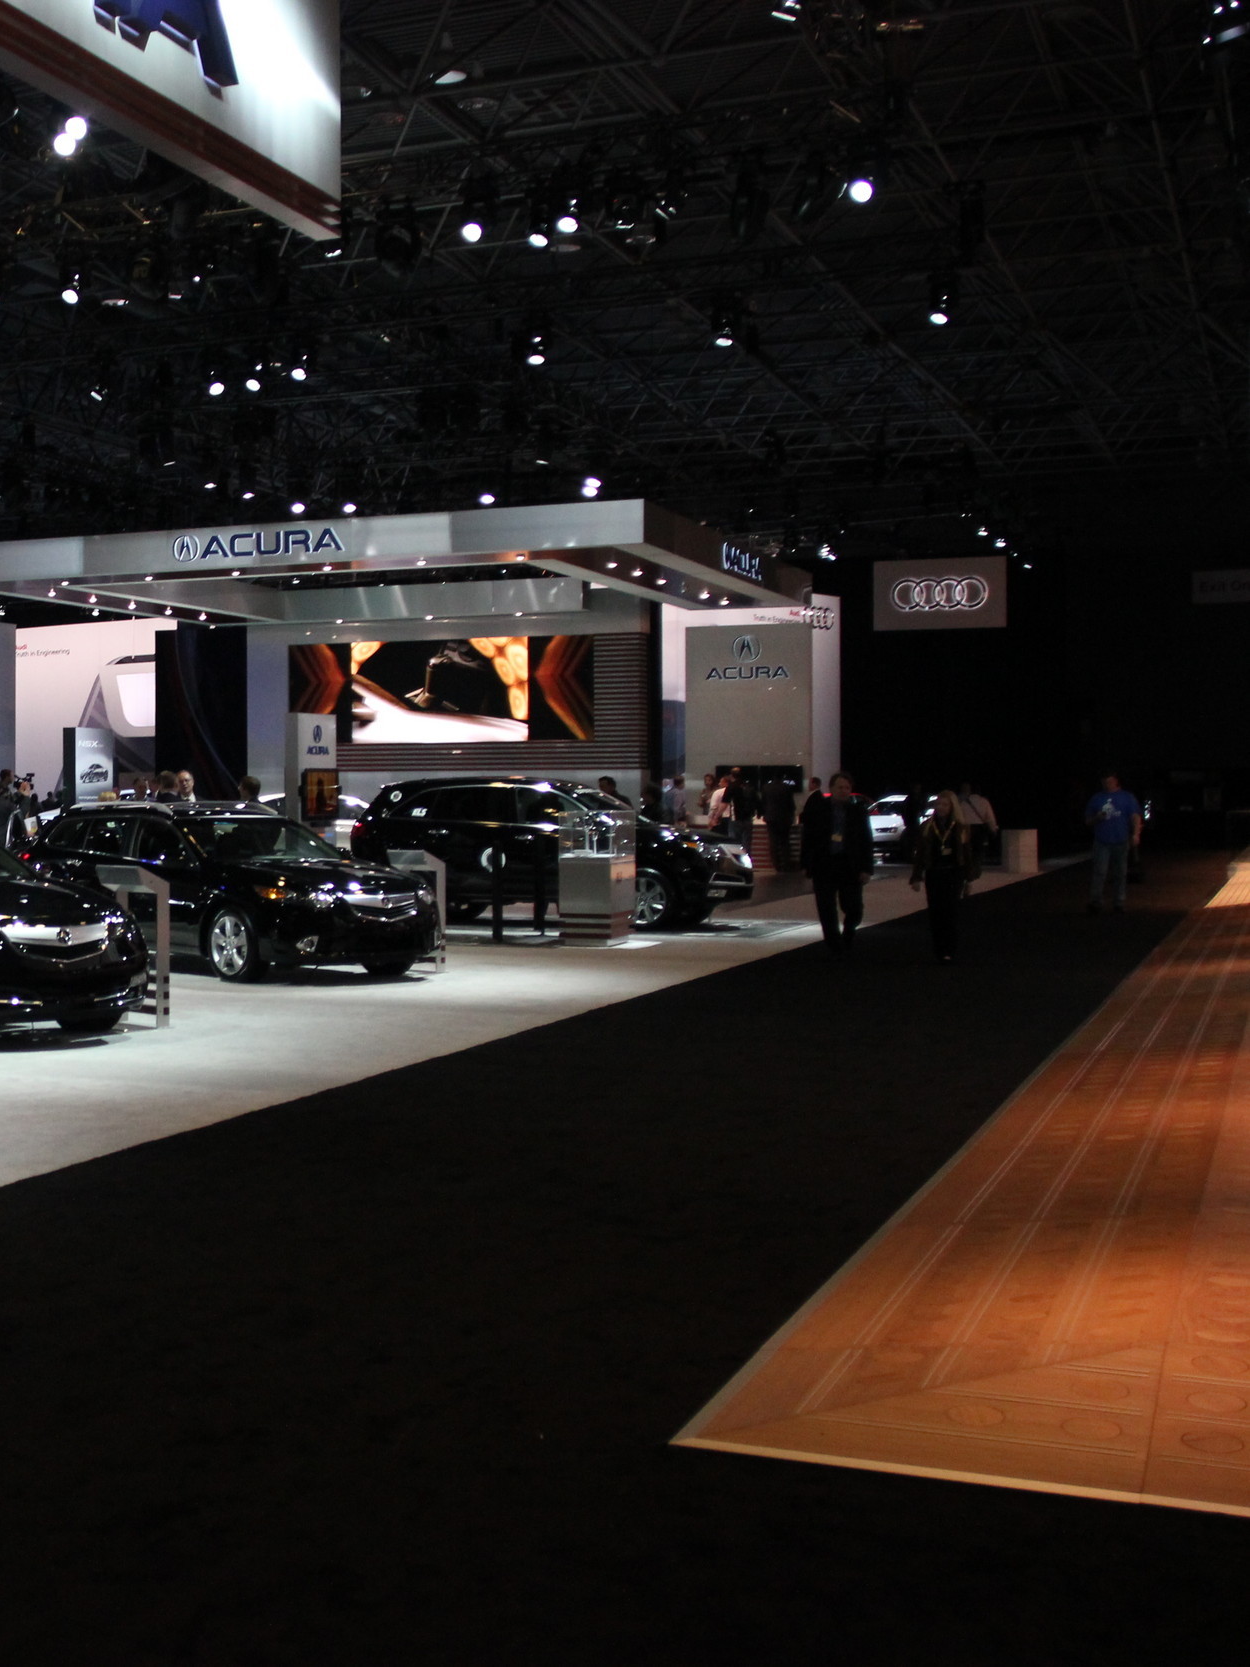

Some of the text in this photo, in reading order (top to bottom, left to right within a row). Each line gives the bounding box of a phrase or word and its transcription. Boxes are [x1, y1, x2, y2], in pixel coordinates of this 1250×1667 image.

[200, 527, 345, 560] ACURA
[36, 648, 70, 657] Engineering
[706, 666, 789, 680] ACURA
[306, 745, 330, 756] ACURA
